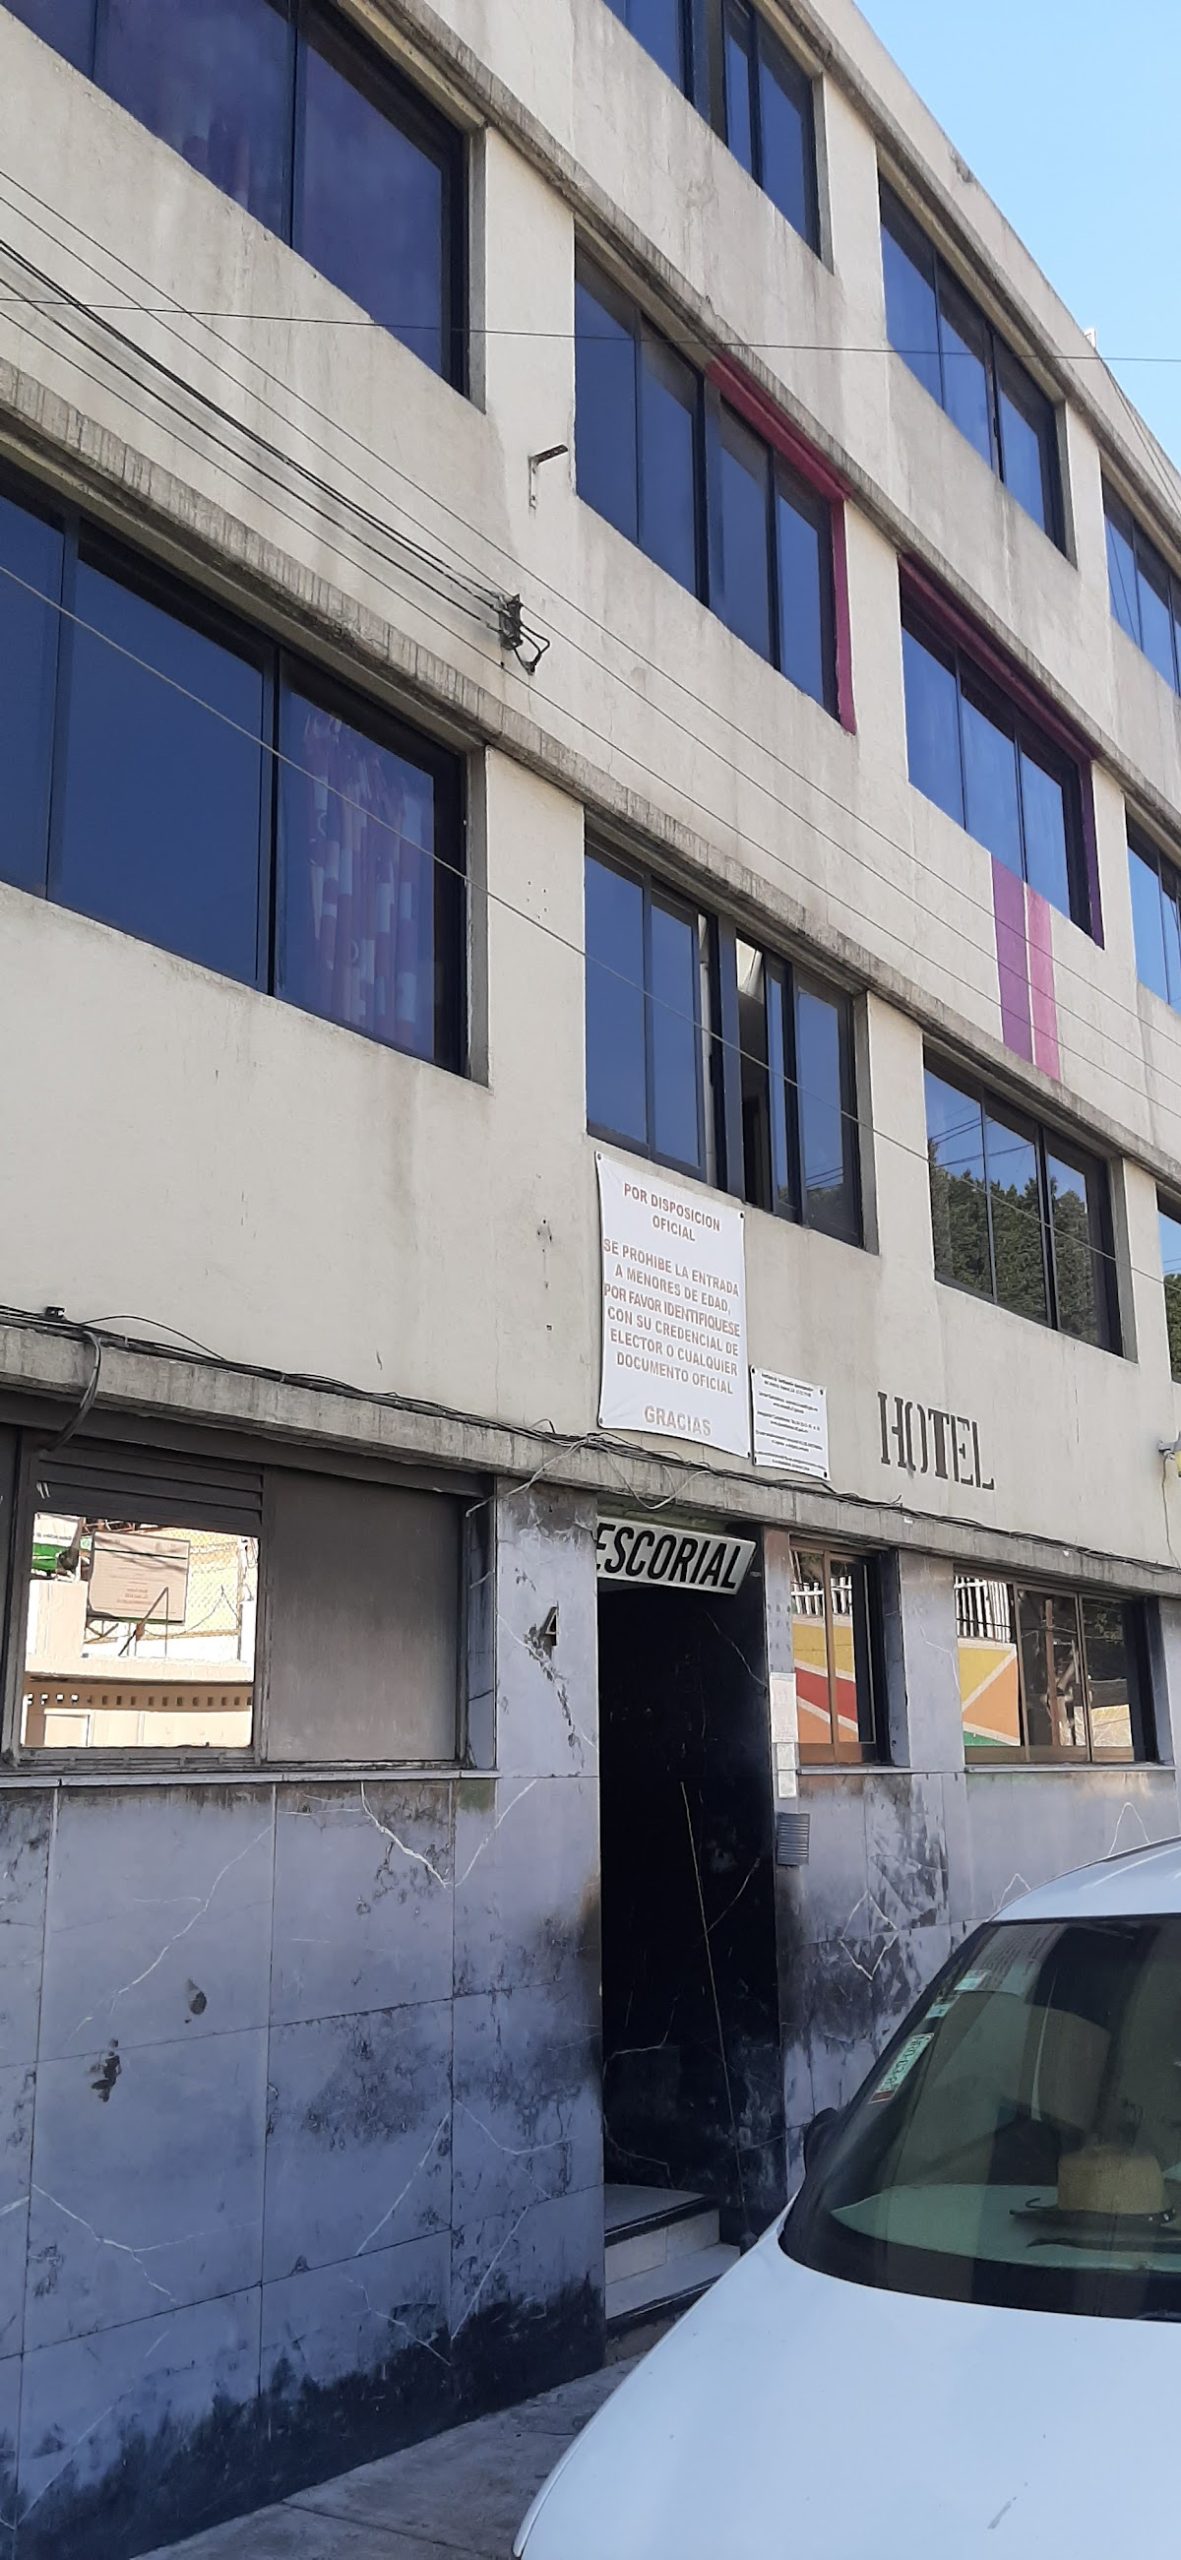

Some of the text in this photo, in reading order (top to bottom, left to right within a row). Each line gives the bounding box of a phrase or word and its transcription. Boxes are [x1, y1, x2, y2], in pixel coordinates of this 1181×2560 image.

[624, 1182, 720, 1231] POR DISPOSICION
[652, 1215, 696, 1241] OFICIAL
[603, 1238, 739, 1297] SE PROHIBE LA ENTRADA
[615, 1263, 623, 1278] A
[627, 1267, 681, 1297] MENORES
[684, 1287, 698, 1302] DE
[604, 1282, 741, 1338] POR FAVOR IDENTIFIQUESE
[607, 1306, 739, 1357] CON SU CREDENCIAL DE
[610, 1327, 738, 1376] ELECTOR O CUALQUIER
[617, 1352, 689, 1383] DOCUMENTO
[692, 1372, 733, 1395] OFICIAL
[644, 1405, 712, 1437] GRACIAS
[878, 1391, 995, 1490] HOTEL
[596, 1522, 741, 1589] ESCORIAL
